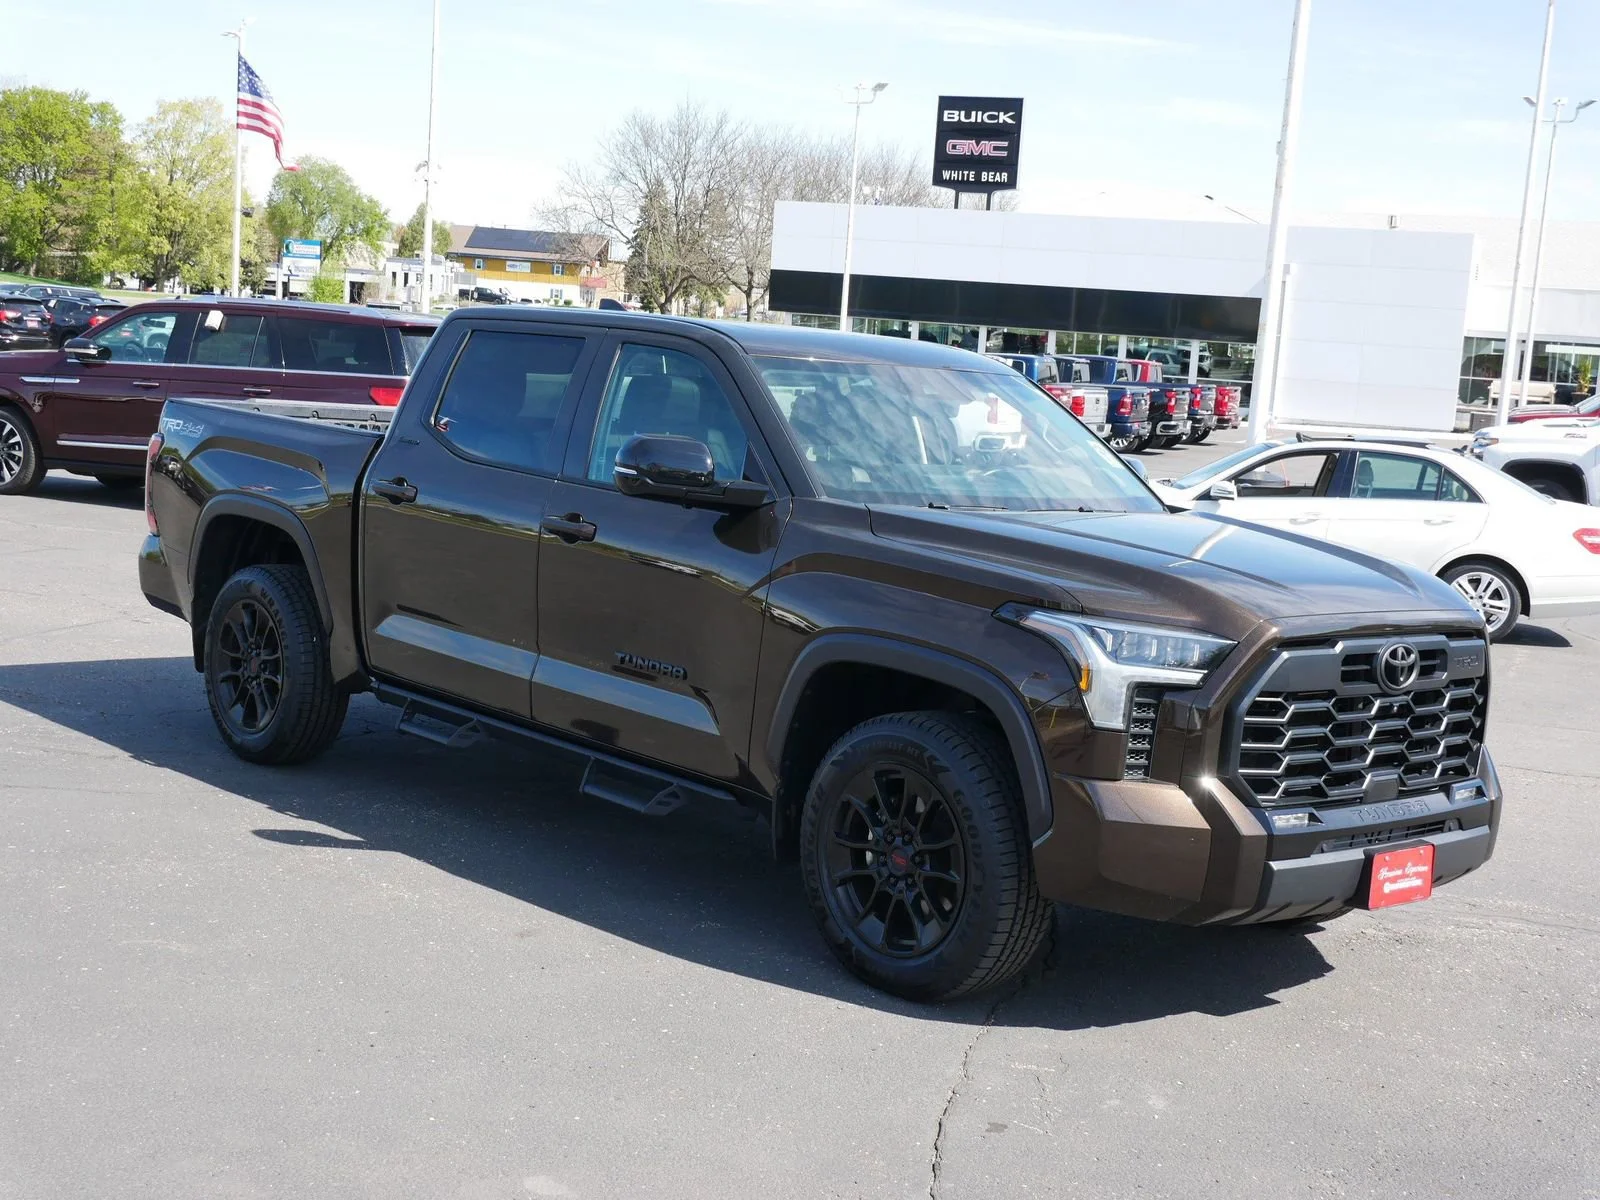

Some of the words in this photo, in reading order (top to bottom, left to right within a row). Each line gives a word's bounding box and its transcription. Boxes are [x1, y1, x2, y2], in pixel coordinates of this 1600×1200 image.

[943, 109, 1016, 124] BUICK
[946, 139, 1009, 157] GMC
[942, 169, 976, 182] WHITE
[981, 171, 1008, 183] BEAR
[162, 417, 183, 432] TRD
[614, 650, 688, 680] TUNDRA
[1350, 799, 1432, 823] TUNDRA
